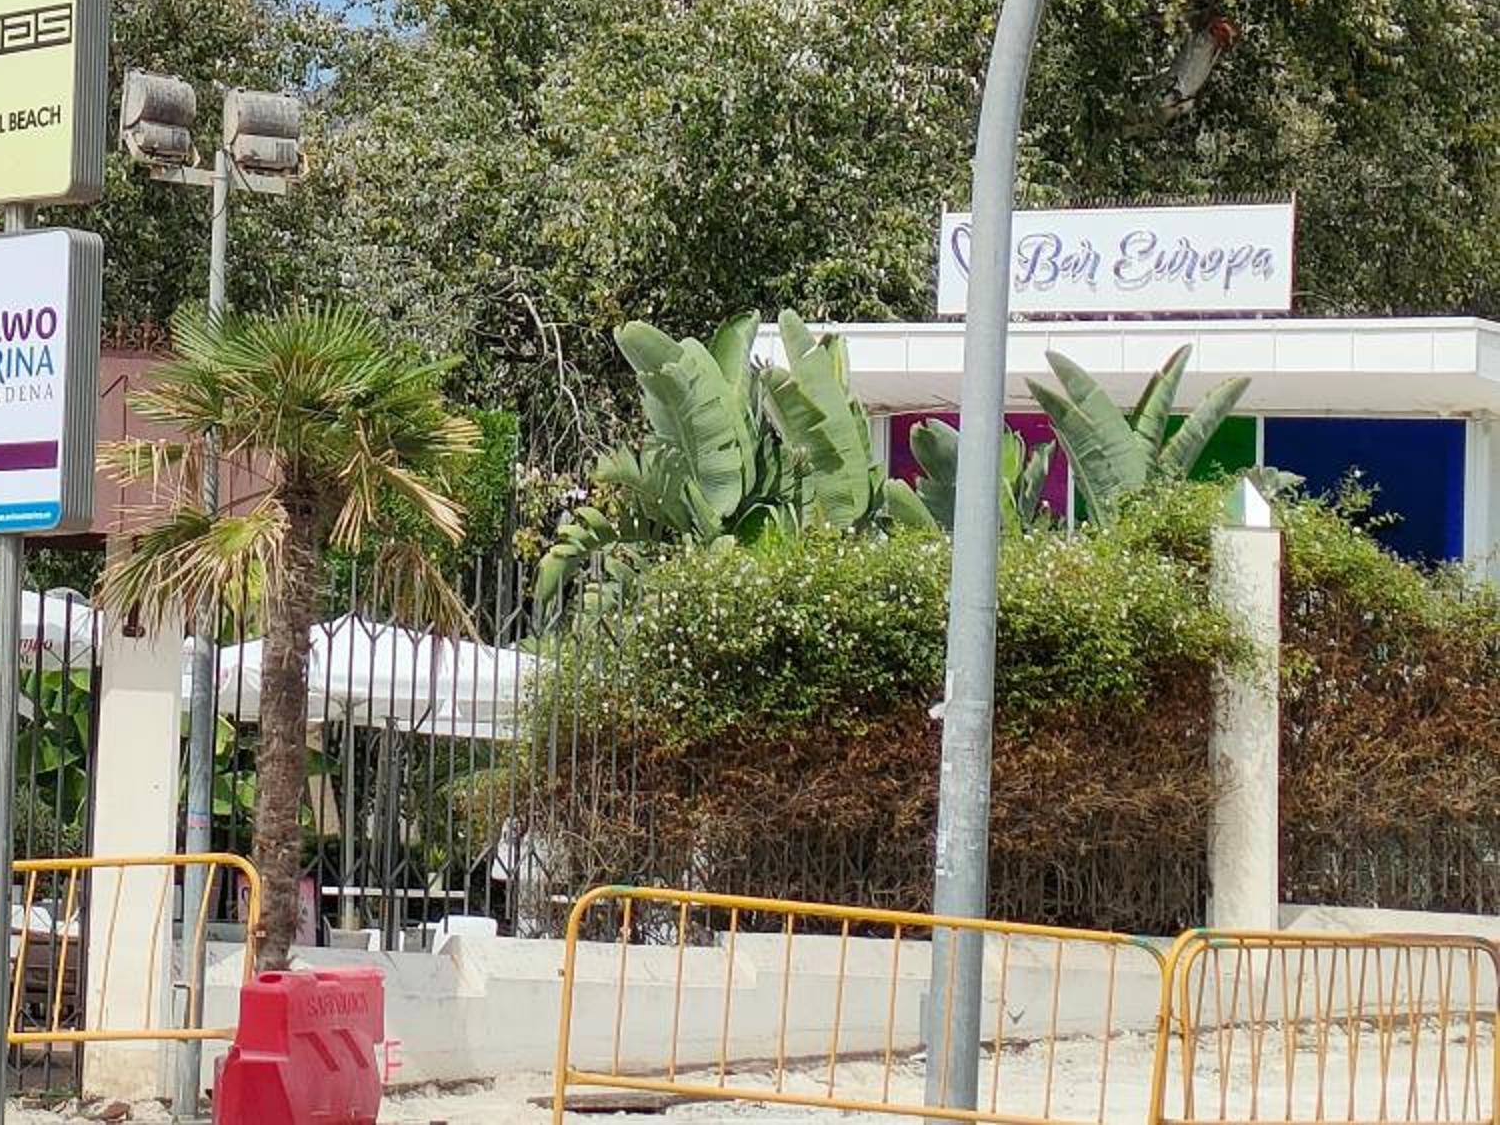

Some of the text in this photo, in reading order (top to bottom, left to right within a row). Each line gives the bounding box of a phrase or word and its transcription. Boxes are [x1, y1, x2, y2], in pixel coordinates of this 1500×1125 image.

[9, 105, 61, 131] BEACH
[1015, 230, 1275, 296] Bar Europa
